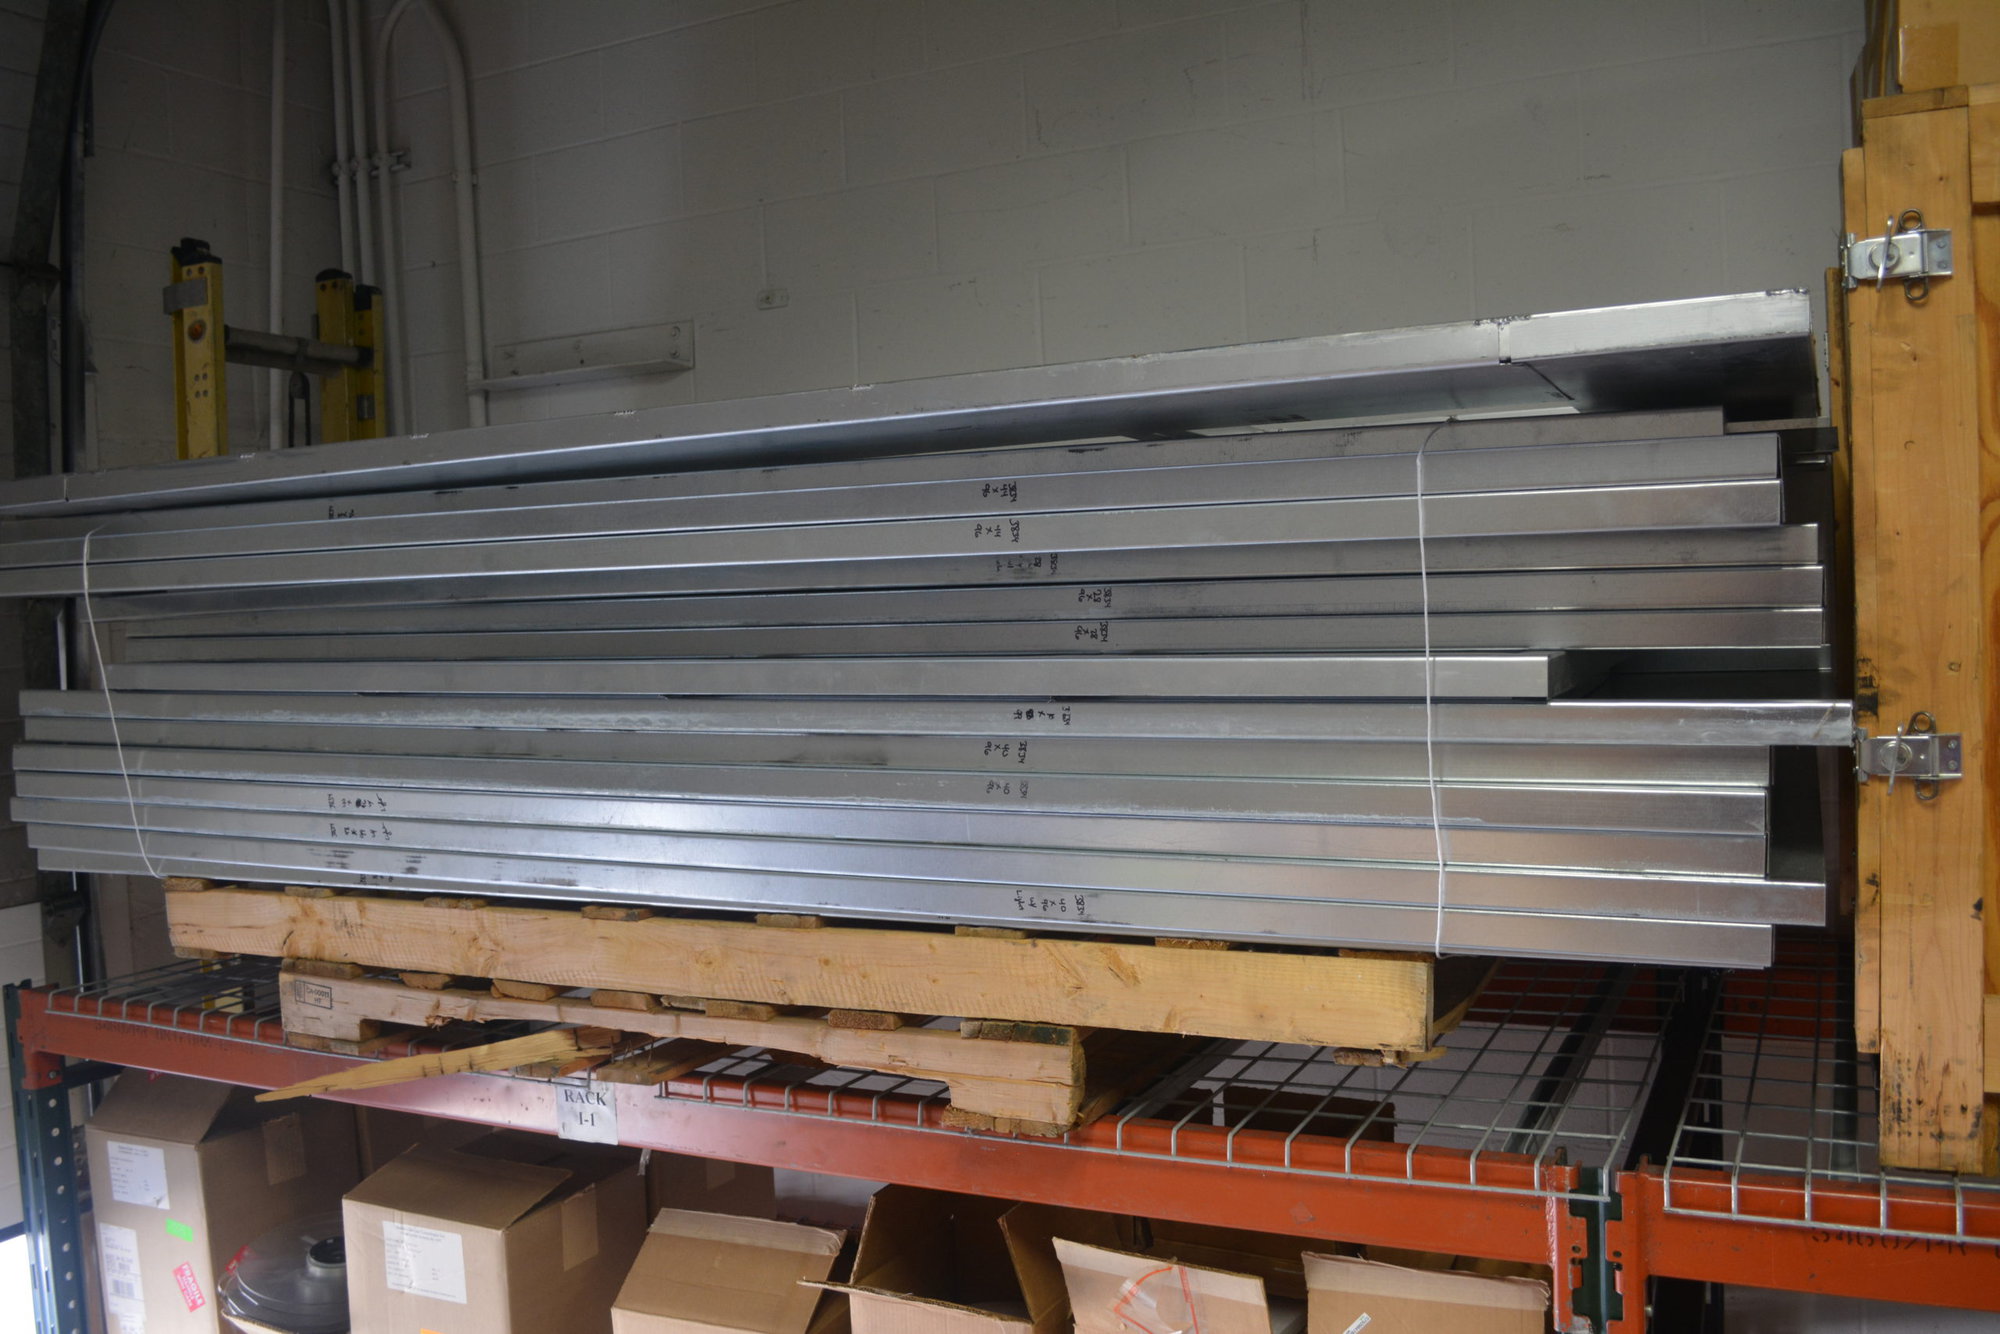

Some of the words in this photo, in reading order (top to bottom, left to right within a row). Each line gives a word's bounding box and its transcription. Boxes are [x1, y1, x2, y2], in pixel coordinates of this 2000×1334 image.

[1000, 484, 1008, 497] 44
[974, 524, 982, 538] 96
[994, 525, 1001, 537] 44
[1009, 518, 1020, 543] 3834
[1078, 588, 1085, 602] 96
[1093, 589, 1101, 602] 28
[1074, 625, 1082, 640] 96
[984, 741, 992, 756] 96
[1041, 899, 1049, 911] 96
[1059, 898, 1067, 912] 40
[1074, 894, 1085, 915] 3834
[564, 1089, 606, 1106] RACK
[182, 1263, 203, 1305] FRAGILE
